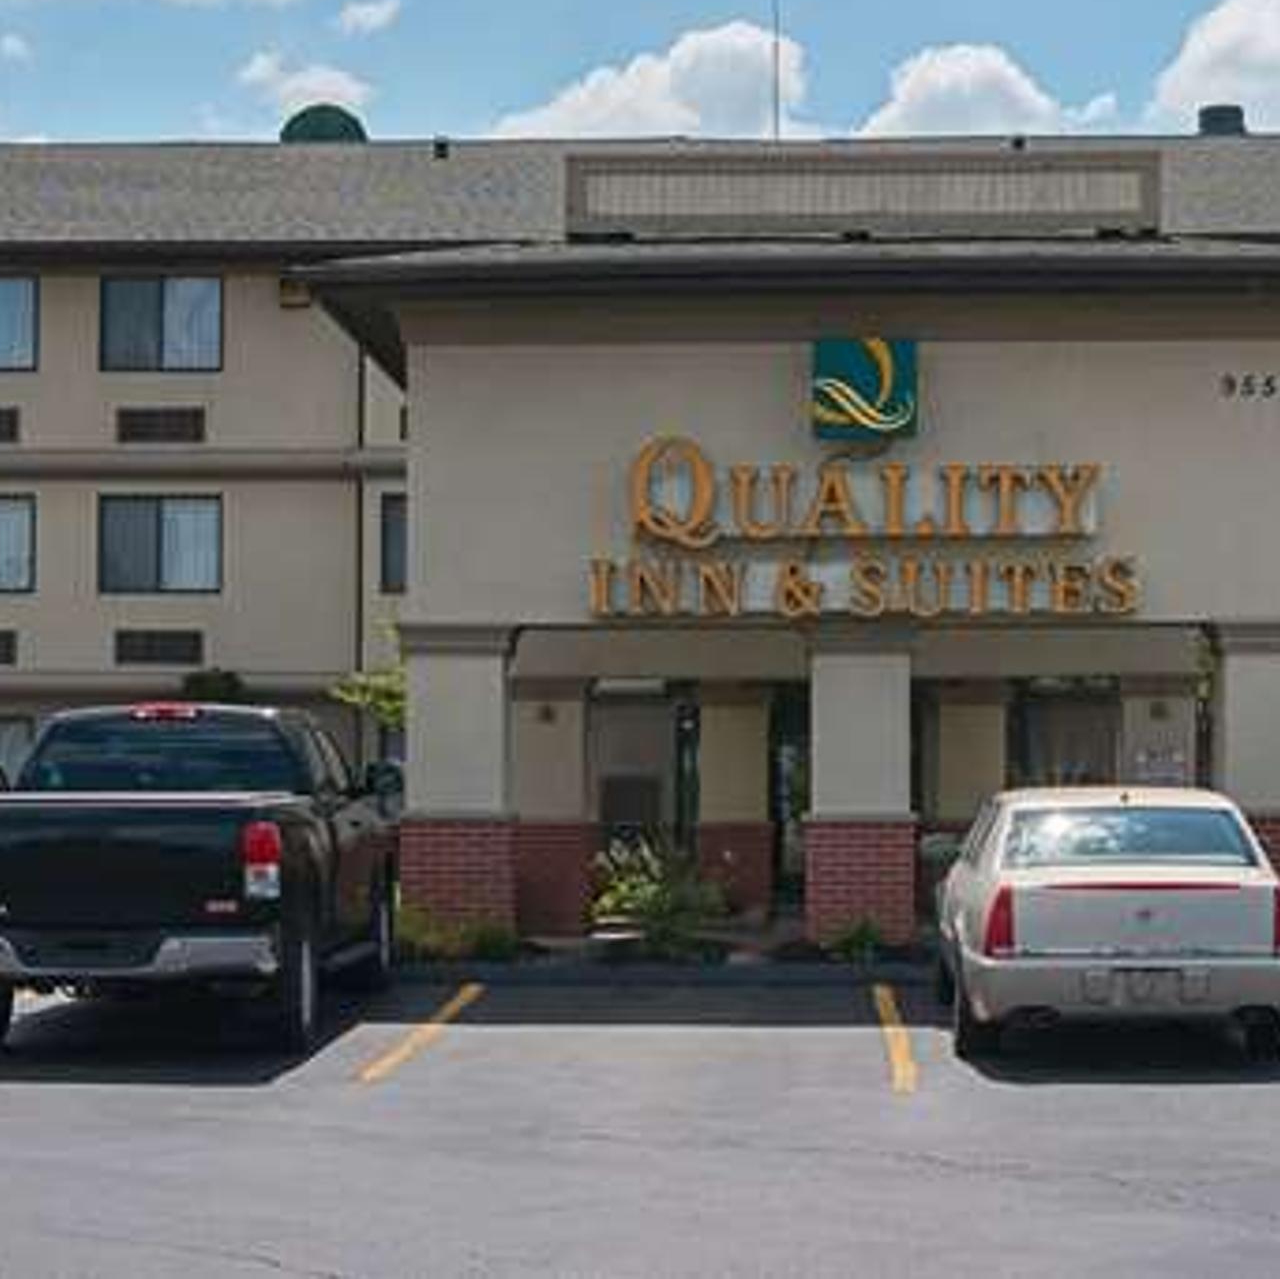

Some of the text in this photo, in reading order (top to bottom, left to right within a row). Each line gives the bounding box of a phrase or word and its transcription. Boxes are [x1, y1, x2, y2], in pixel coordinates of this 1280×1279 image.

[631, 436, 1100, 547] QUALITY
[589, 556, 1142, 616] INN & SUITES
